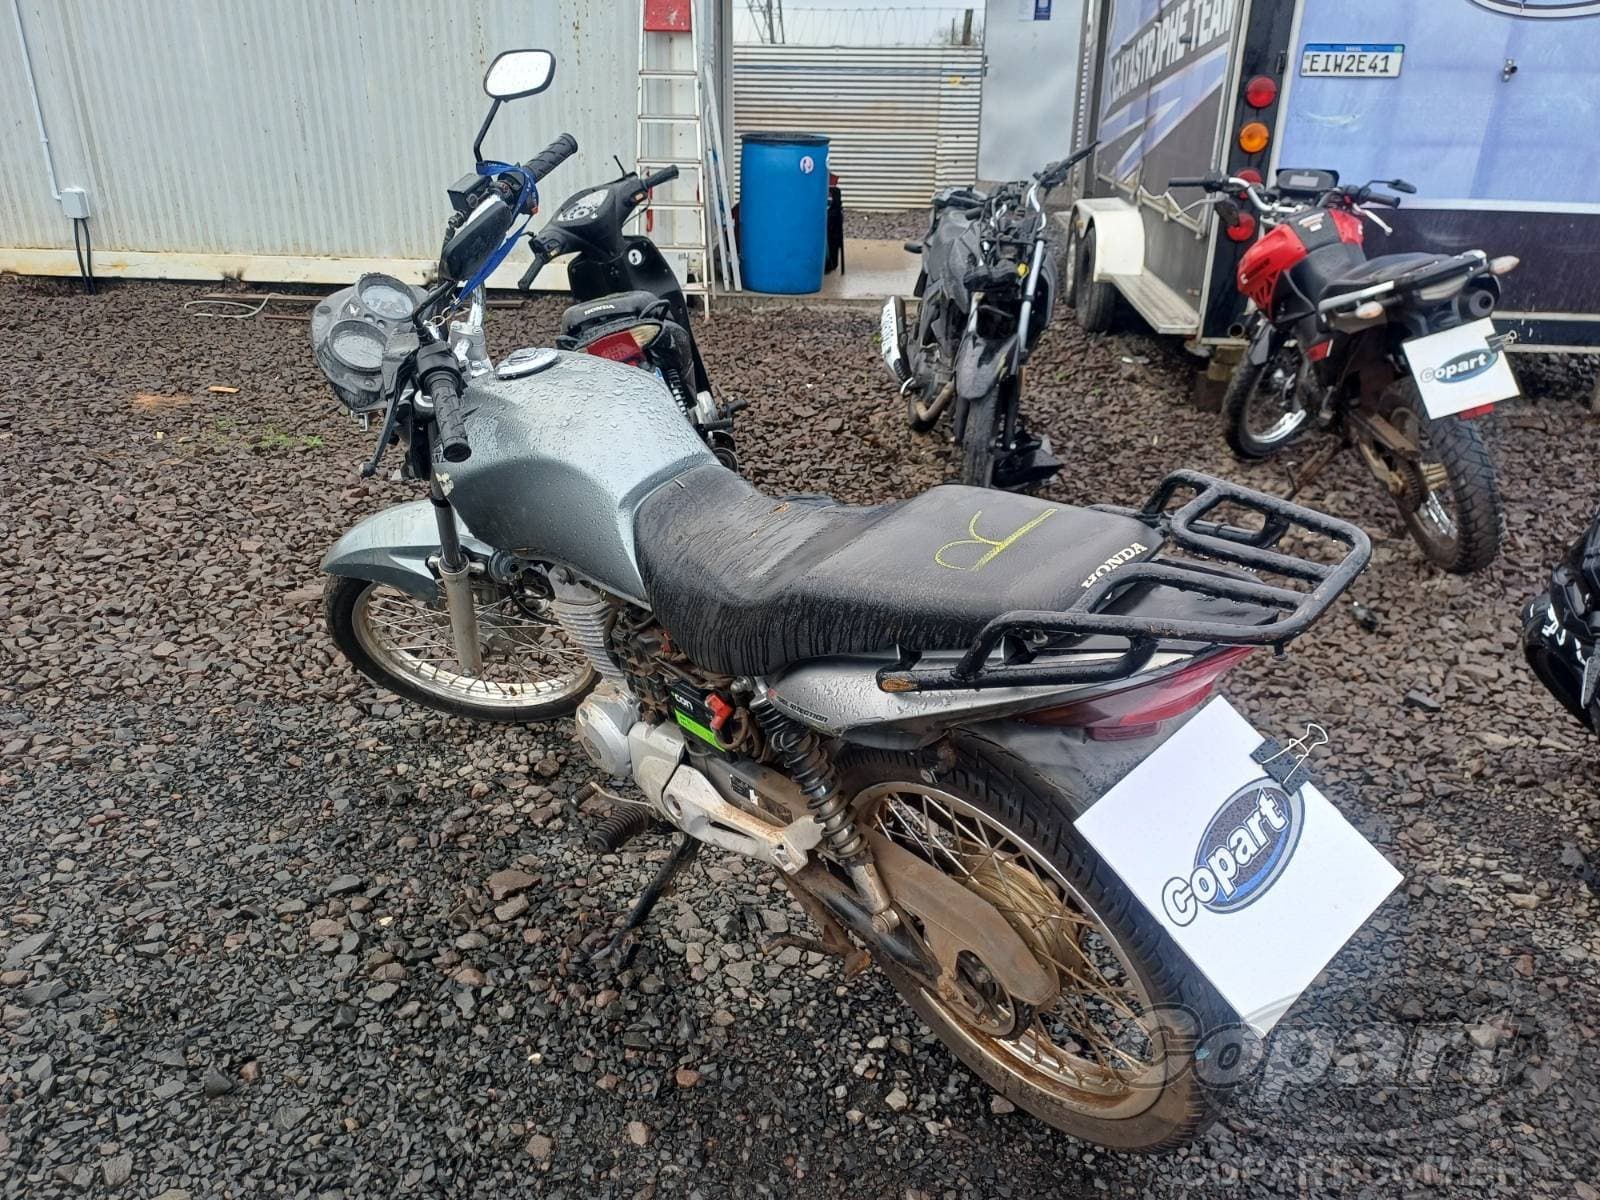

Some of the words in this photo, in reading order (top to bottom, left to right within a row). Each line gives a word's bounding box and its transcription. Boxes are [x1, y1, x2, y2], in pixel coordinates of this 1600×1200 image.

[1309, 54, 1390, 73] EIW2E41
[584, 304, 616, 316] HONDA
[1421, 353, 1487, 383] Copart
[1162, 786, 1289, 928] Copart
